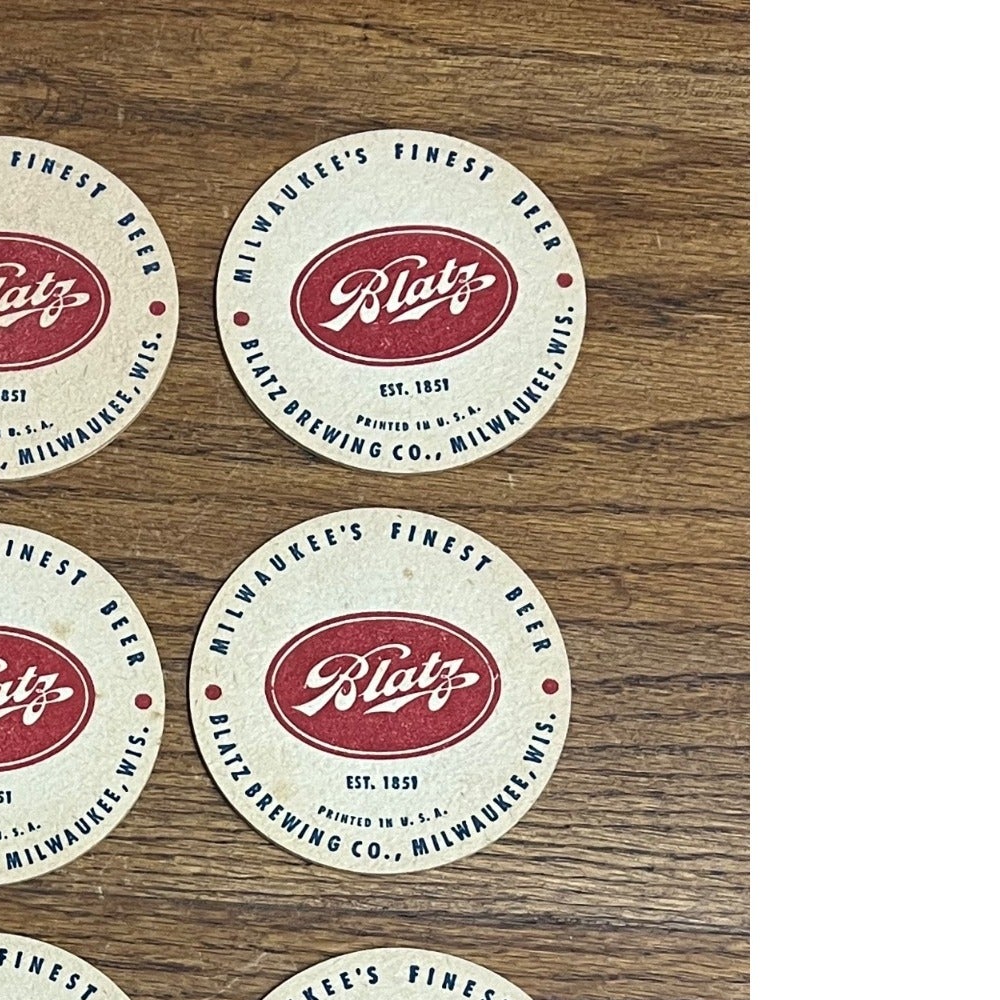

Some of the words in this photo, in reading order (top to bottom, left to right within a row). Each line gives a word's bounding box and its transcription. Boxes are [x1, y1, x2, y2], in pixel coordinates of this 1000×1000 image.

[11, 151, 106, 198] FINEST
[118, 213, 160, 275] BEER
[233, 148, 367, 283] MILWAUKEE'S
[395, 143, 493, 181] FINEST
[511, 191, 561, 250] BEER
[319, 255, 496, 331] Blatz
[19, 386, 140, 465] MILWAUKEE,
[129, 333, 162, 379] WIS.
[241, 339, 287, 401] BLATZ
[284, 400, 381, 458] BREWING
[393, 444, 441, 460] CO.,
[450, 362, 562, 454] MILWAUKEE,
[547, 307, 574, 354] WIS.
[356, 415, 409, 431] PRINTED
[380, 383, 409, 397] EST.
[416, 378, 449, 394] 1851
[100, 600, 145, 666] BEER
[209, 523, 361, 655] MILWAUKEE'S
[391, 523, 492, 571] FINEST
[505, 587, 551, 652] BEER
[292, 644, 479, 716] Blatz
[6, 785, 128, 870] MILWAUKEE,
[116, 727, 149, 776] WIS.
[209, 715, 251, 781] BLATZ
[245, 783, 341, 852] BREWING
[352, 841, 401, 861] CO.,
[412, 771, 536, 856] MILWAUKEE,
[523, 714, 556, 763] WIS.
[318, 806, 371, 827] PRINTED
[379, 818, 393, 828] IN
[346, 776, 375, 790] EST.
[383, 776, 417, 790] 1851
